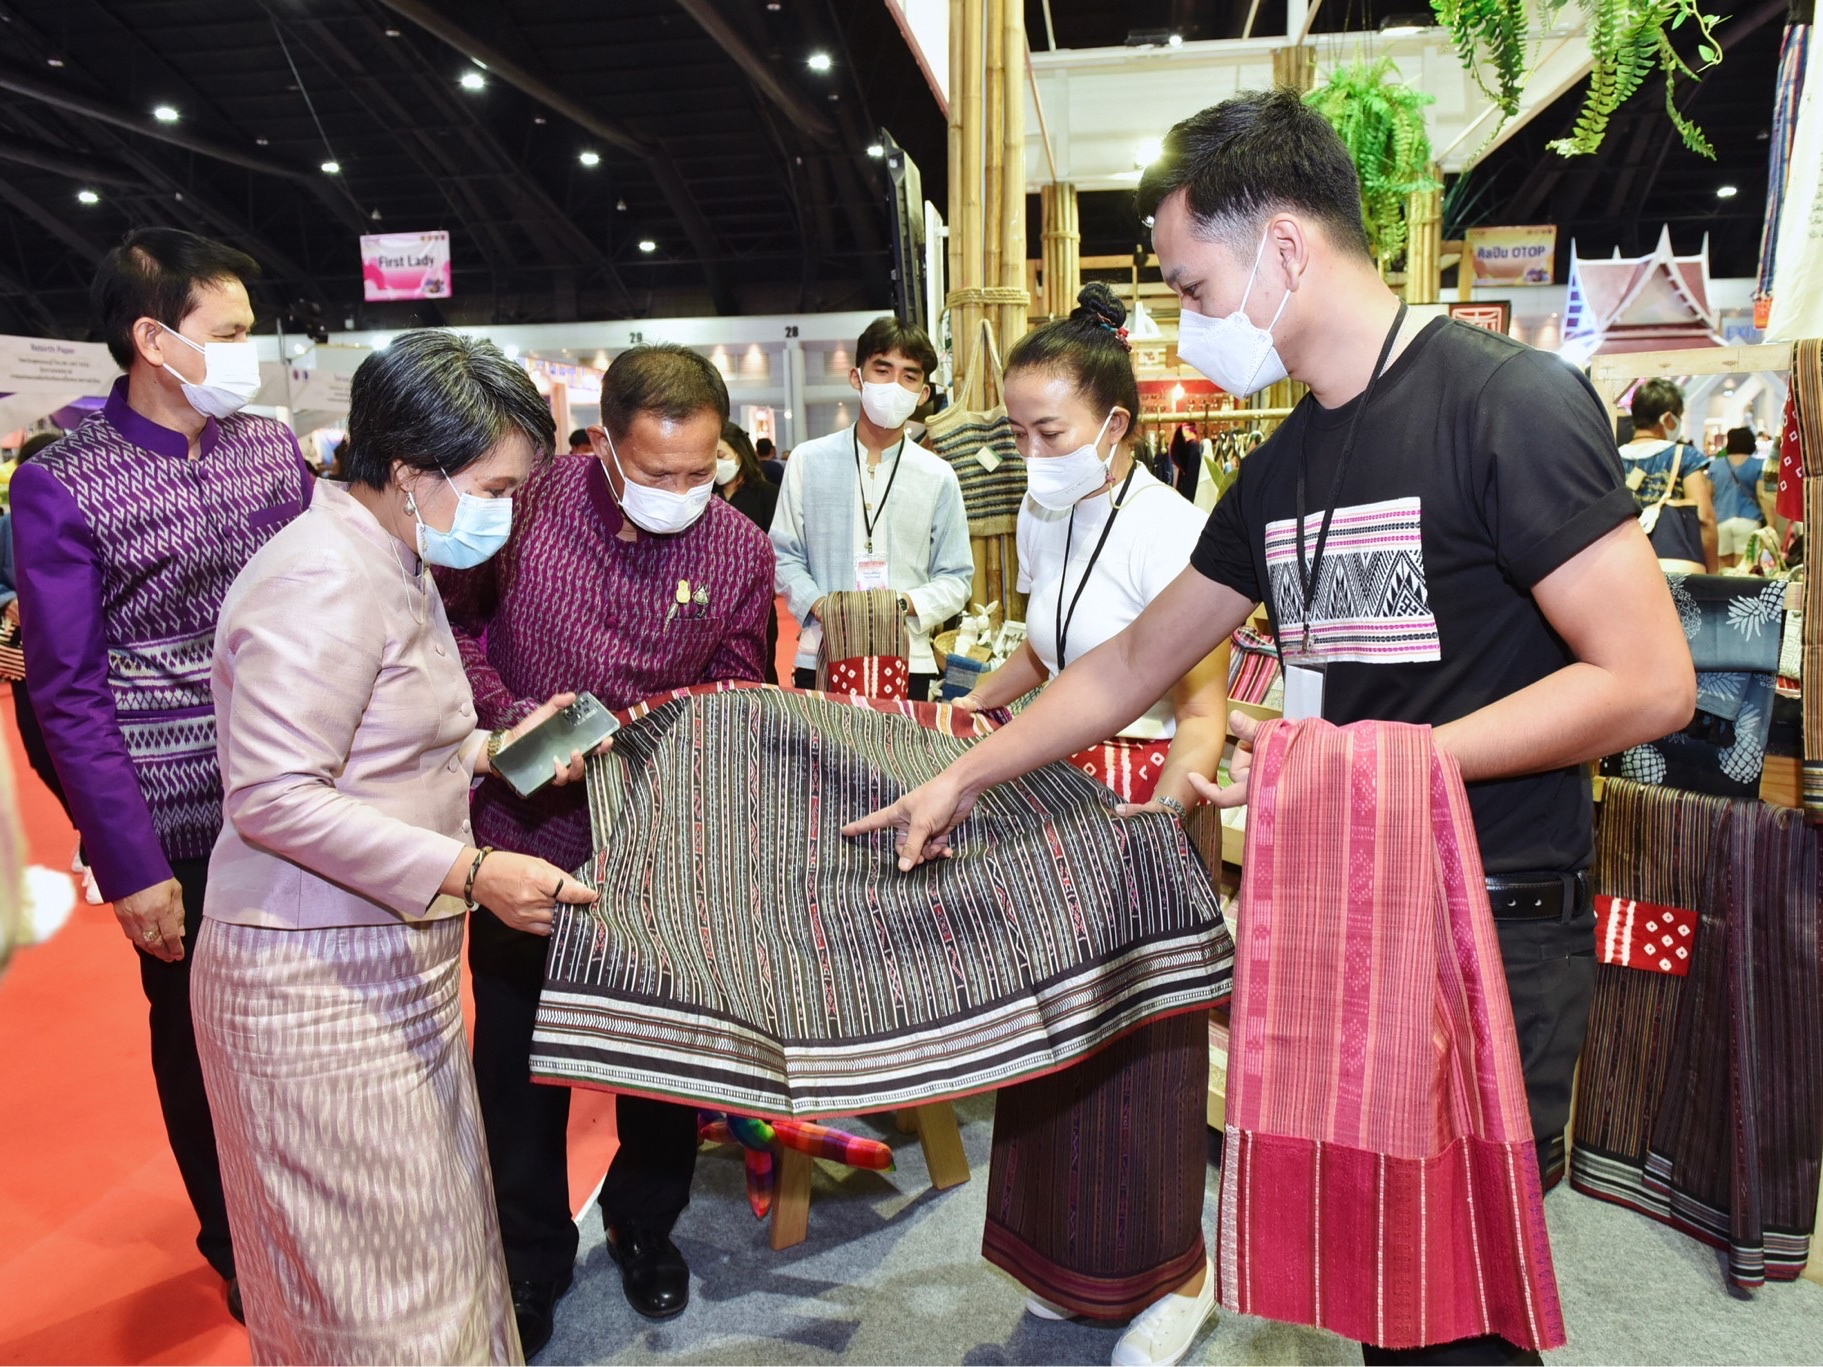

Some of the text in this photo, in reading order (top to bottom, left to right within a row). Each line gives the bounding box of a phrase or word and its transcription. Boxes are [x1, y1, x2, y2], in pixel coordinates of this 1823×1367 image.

[1512, 245, 1546, 257] OTOP
[378, 254, 434, 268] First Lady
[629, 332, 643, 343] 29
[785, 326, 799, 338] 28
